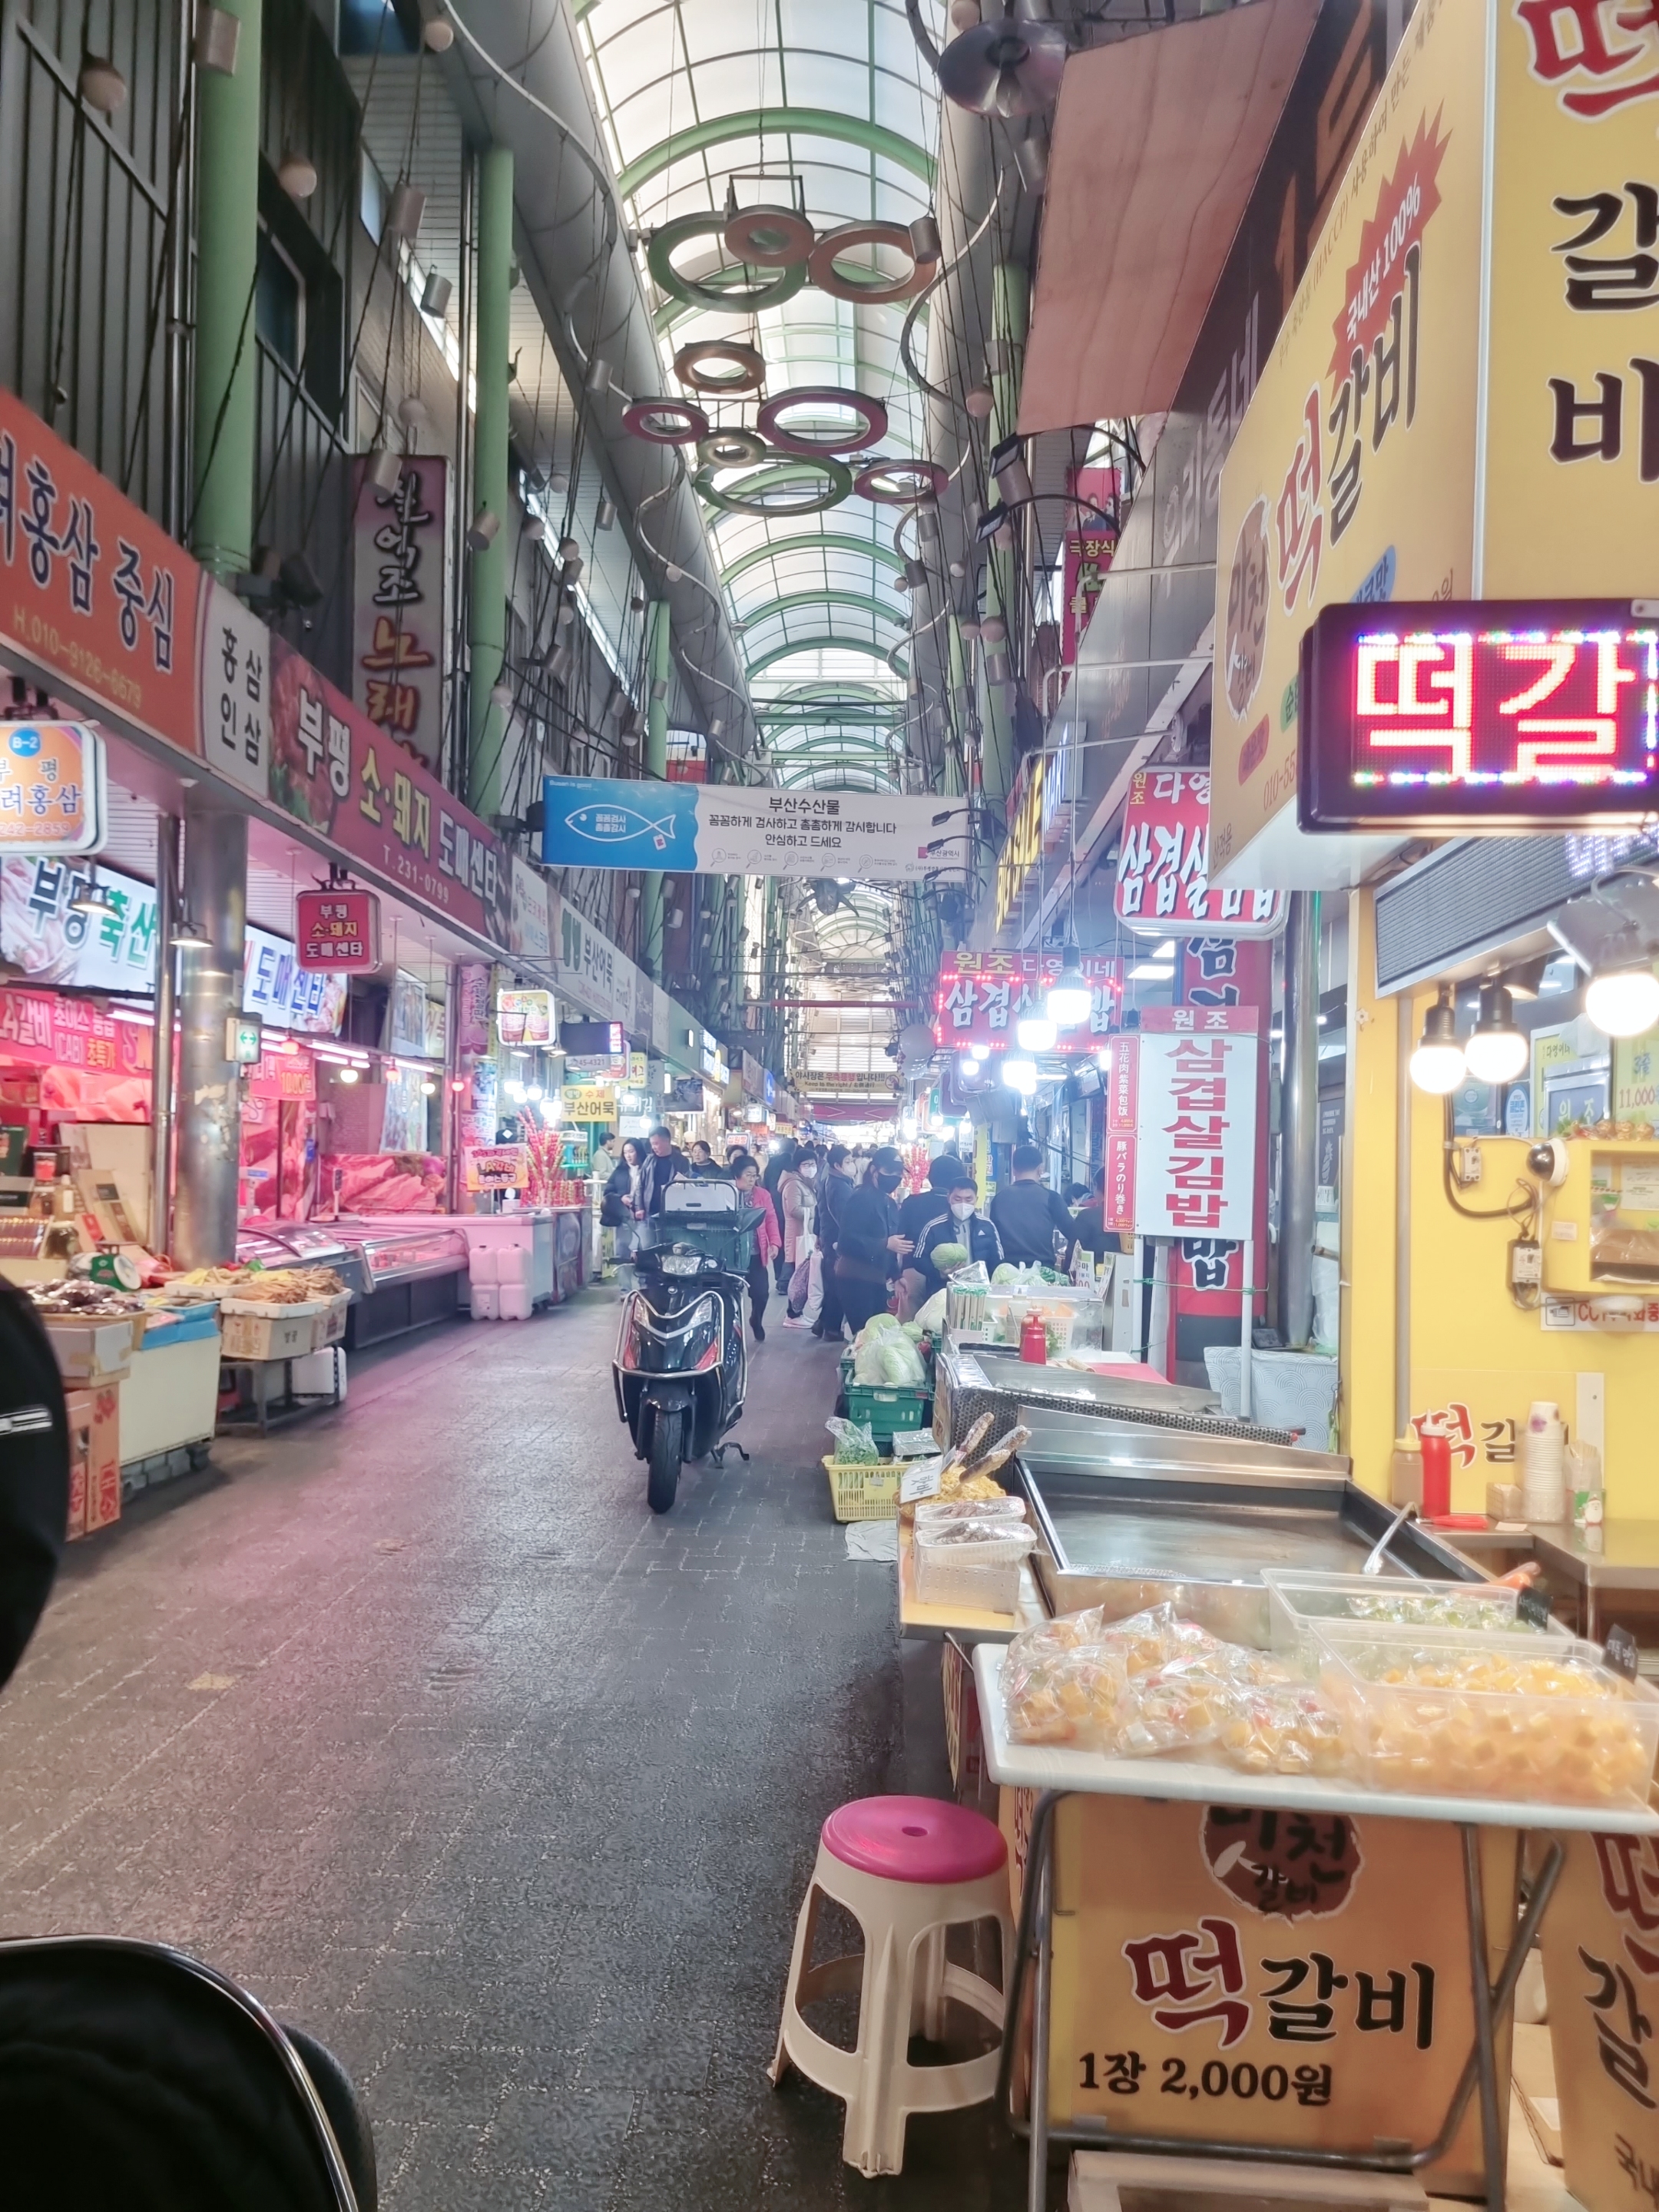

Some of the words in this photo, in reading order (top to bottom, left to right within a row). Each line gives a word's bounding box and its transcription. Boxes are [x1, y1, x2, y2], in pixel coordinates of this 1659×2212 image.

[1313, 194, 1349, 292] (HACCP)
[1346, 246, 1382, 343] 국내산
[1382, 172, 1421, 280] 100%
[1275, 240, 1422, 616] 떡갈비
[1069, 539, 1114, 558] 극장식
[114, 539, 174, 672] 중심
[221, 627, 263, 703] 홍삼
[220, 693, 261, 766] 인삼
[1356, 637, 1637, 785] 떡갈
[12, 737, 38, 749] B-2
[298, 686, 351, 797] 부평
[360, 747, 431, 862] 소·돼지
[439, 810, 498, 912] 도매센타
[769, 796, 840, 816] 부산수산물
[1130, 773, 1147, 805] 원조
[709, 814, 752, 828] 꼼꼼하게
[755, 816, 797, 830] 검사하고
[800, 819, 843, 832] 촘촘하게
[846, 820, 897, 834] 감시합니다
[765, 833, 808, 847] 안심하고
[810, 836, 843, 849] 드세요
[320, 904, 348, 919] 부평
[306, 941, 363, 959] 도매센타
[583, 932, 614, 994] 부산어묵
[953, 952, 1015, 975] 원조
[250, 945, 327, 1019] 도매센타
[943, 979, 1115, 1034] 삼겹밥
[1172, 1009, 1229, 1031] 원조
[585, 1090, 605, 1099] 수제
[795, 1071, 824, 1081] 야시장은
[1619, 1084, 1659, 1109] 11,000
[564, 1101, 614, 1115] 부산어묵
[1161, 1039, 1233, 1229] 삼겹살김밥
[1115, 1141, 1128, 1215] 豚バラのり巻き
[1123, 1918, 1435, 2048] 떡갈비
[1078, 2054, 1146, 2094] 1장
[1160, 2058, 1333, 2106] 2,000원
